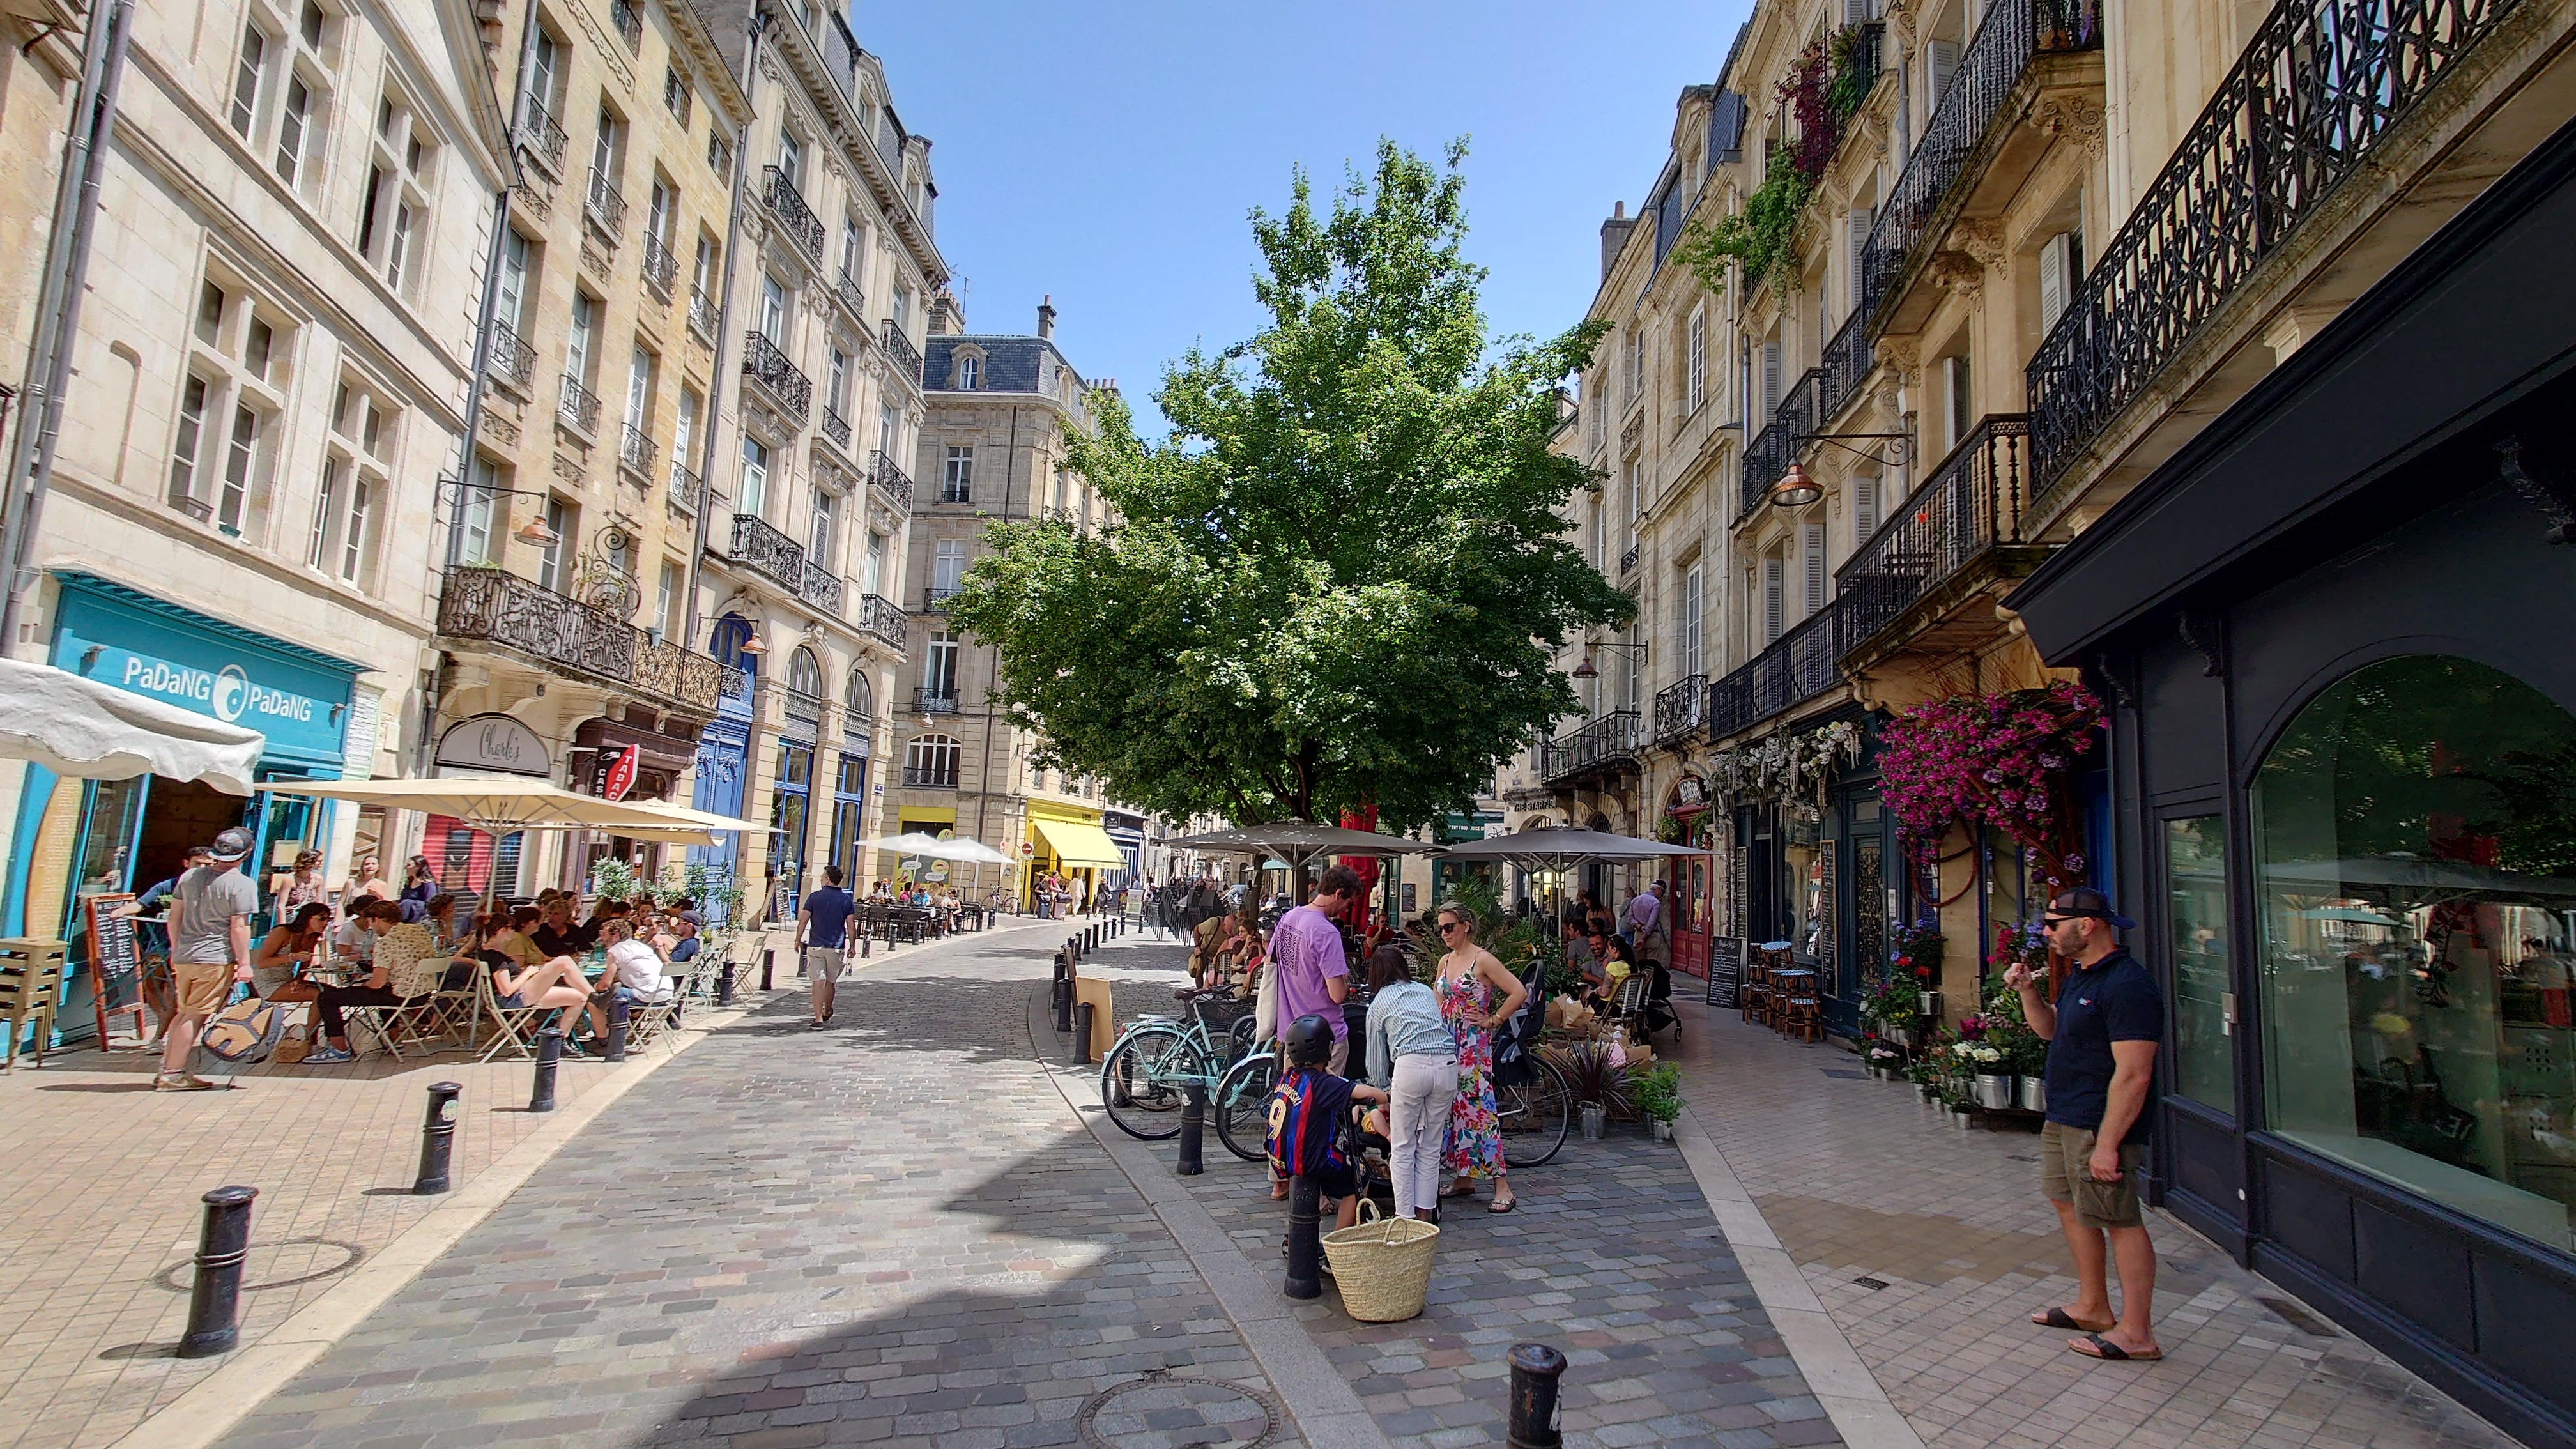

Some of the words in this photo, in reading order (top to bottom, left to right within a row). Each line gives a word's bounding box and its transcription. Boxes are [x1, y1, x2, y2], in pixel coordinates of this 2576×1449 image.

[123, 657, 211, 700] PaDaNG
[248, 686, 312, 721] PaDaNG
[608, 755, 632, 800] TABAC
[1267, 1098, 1287, 1140] 9
